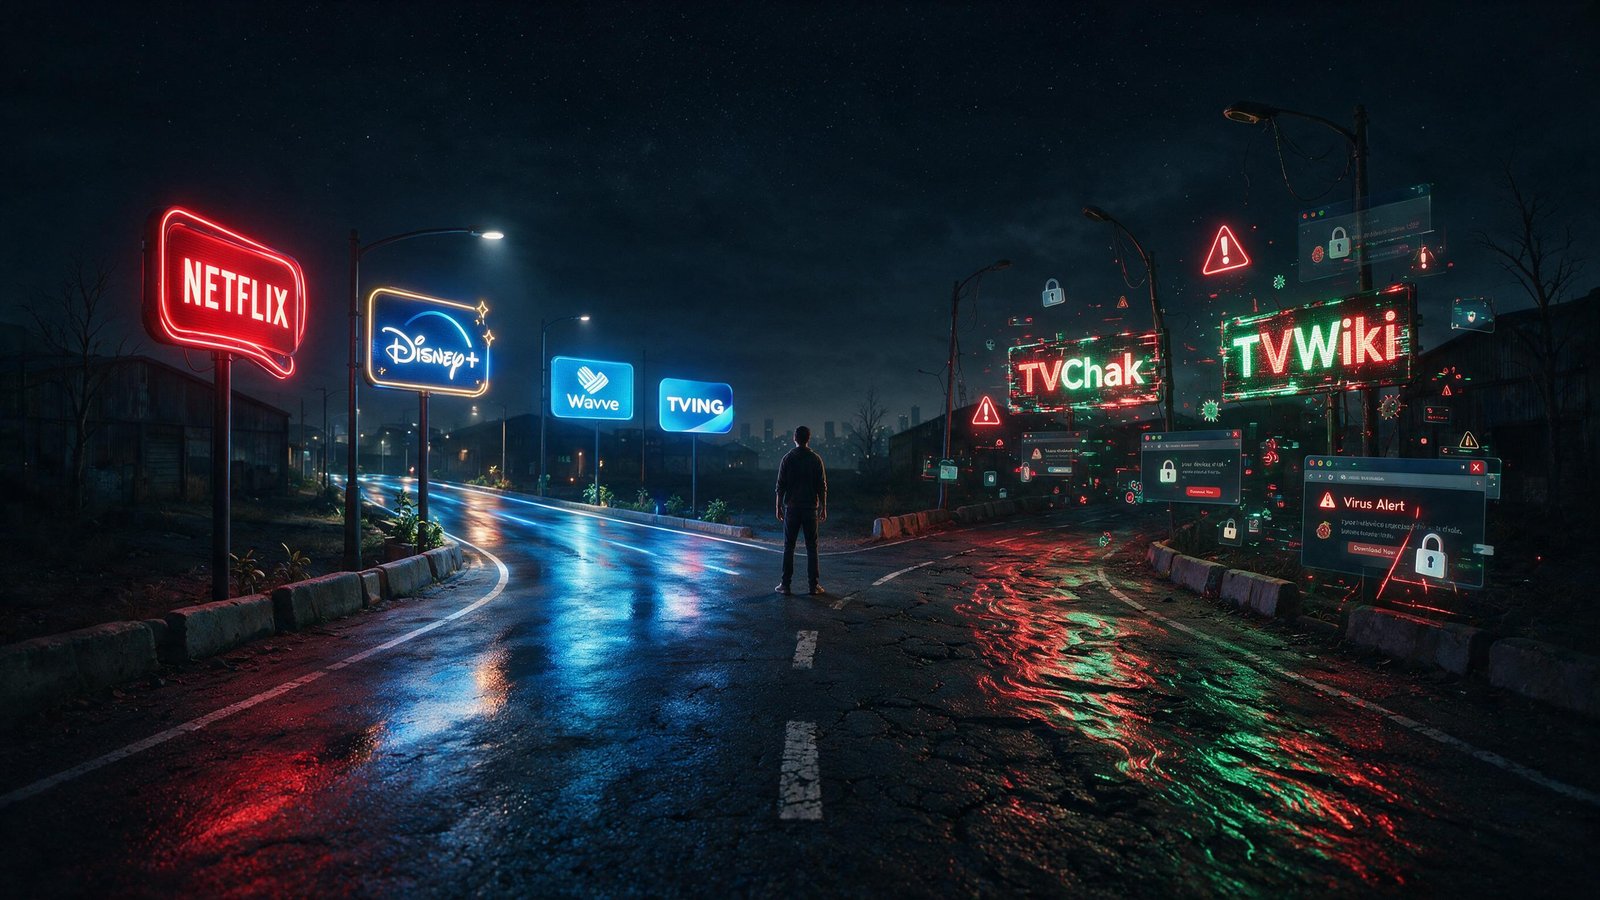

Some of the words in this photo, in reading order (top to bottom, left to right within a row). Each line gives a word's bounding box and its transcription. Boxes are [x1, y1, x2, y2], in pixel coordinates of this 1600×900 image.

[184, 257, 289, 329] NETFLIX
[381, 327, 479, 380] Disney+
[1233, 311, 1396, 378] TVWiki
[1018, 352, 1145, 393] TVChak
[567, 393, 619, 411] Wavve
[667, 396, 724, 415] TVING
[1343, 496, 1372, 509] Virus
[1376, 498, 1405, 512] Alert
[1353, 545, 1382, 554] Download
